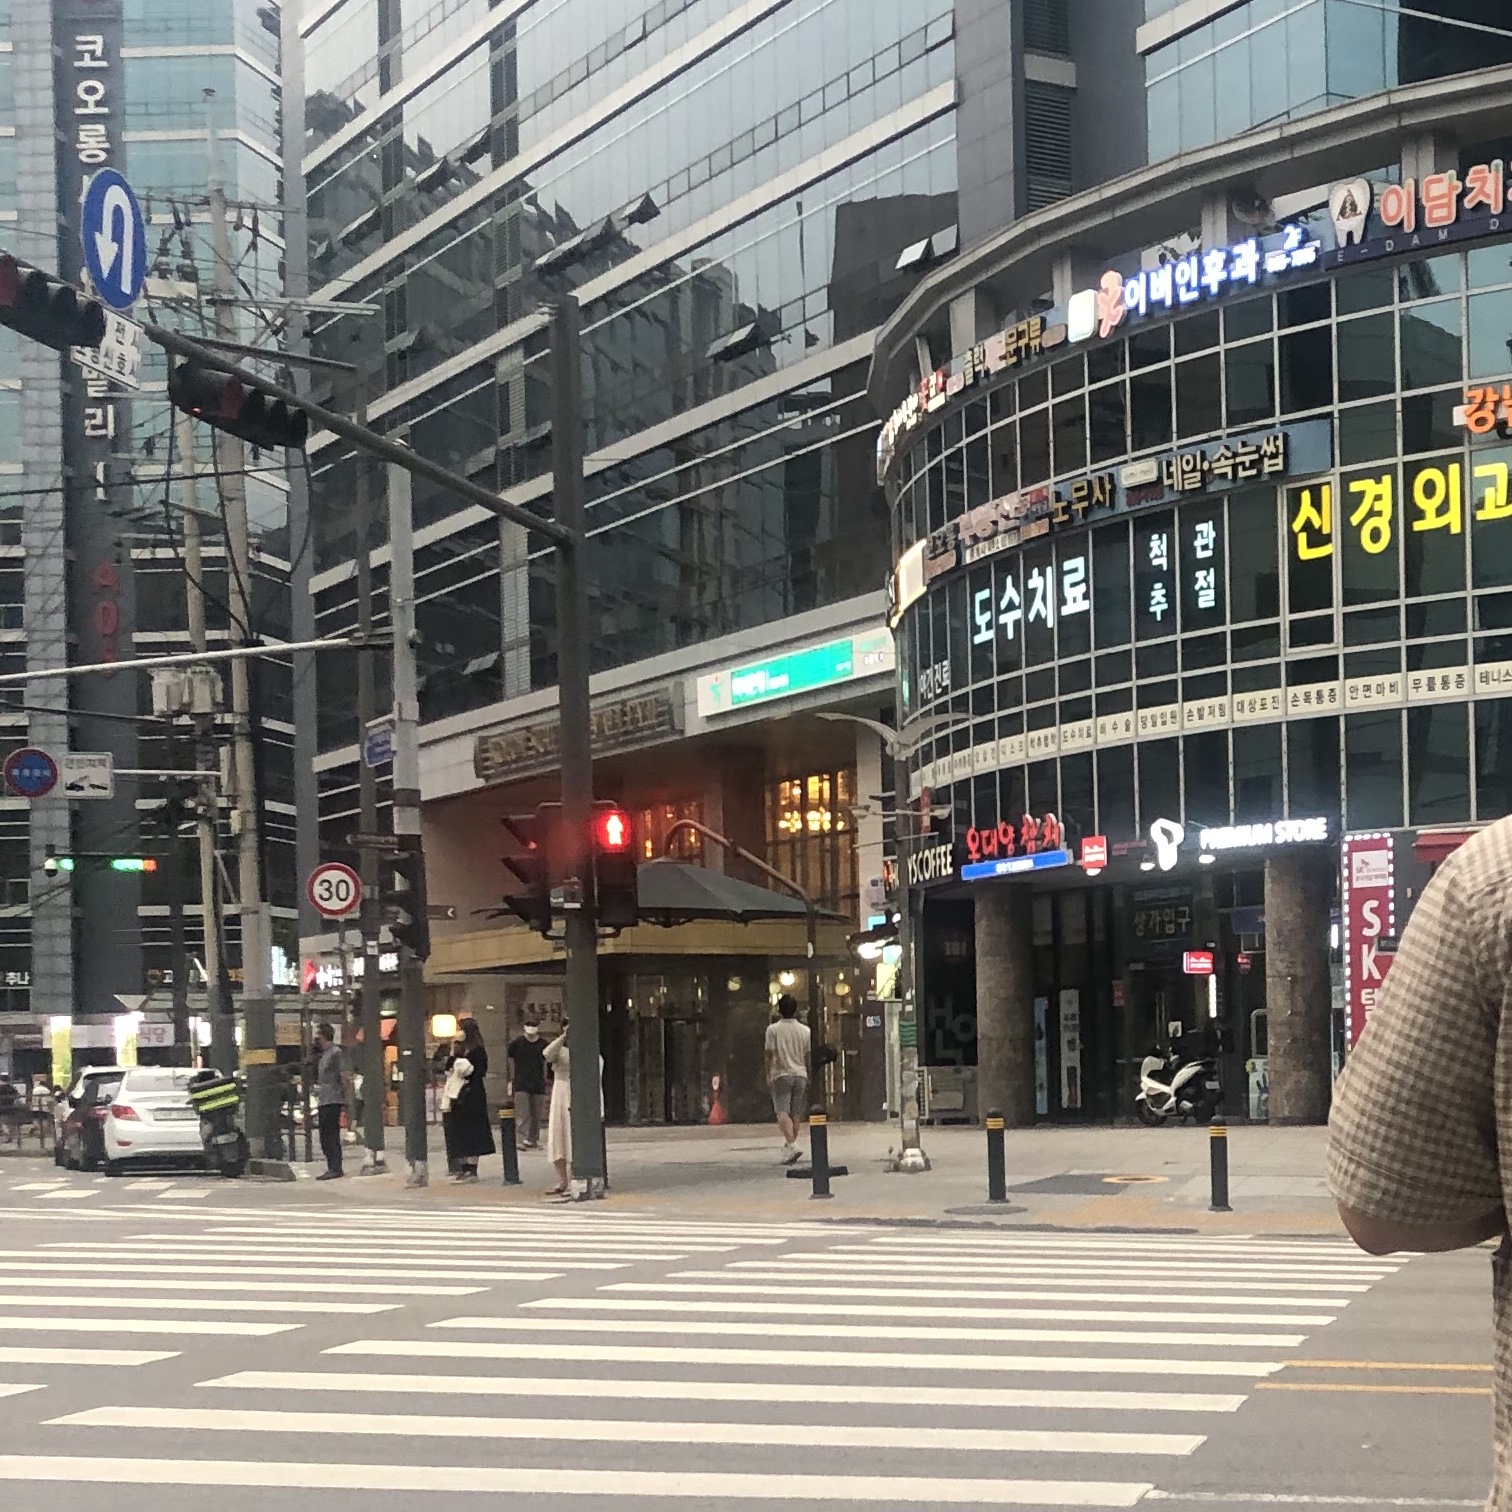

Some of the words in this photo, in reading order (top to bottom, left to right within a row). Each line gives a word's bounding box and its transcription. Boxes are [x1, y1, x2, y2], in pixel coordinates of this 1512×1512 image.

[1123, 237, 1261, 317] 이비인후과
[1052, 472, 1112, 524] 노무사
[971, 555, 1091, 645] 도수치료
[1236, 694, 1280, 713] 대상포진
[1291, 687, 1338, 708] 손목통증
[1349, 680, 1399, 700] 안면마비
[1411, 673, 1467, 693] 무릎통증
[966, 821, 1015, 861] 오대양
[1274, 816, 1328, 844] STORE
[318, 879, 351, 904] 30
[1134, 906, 1192, 938] 상가입구
